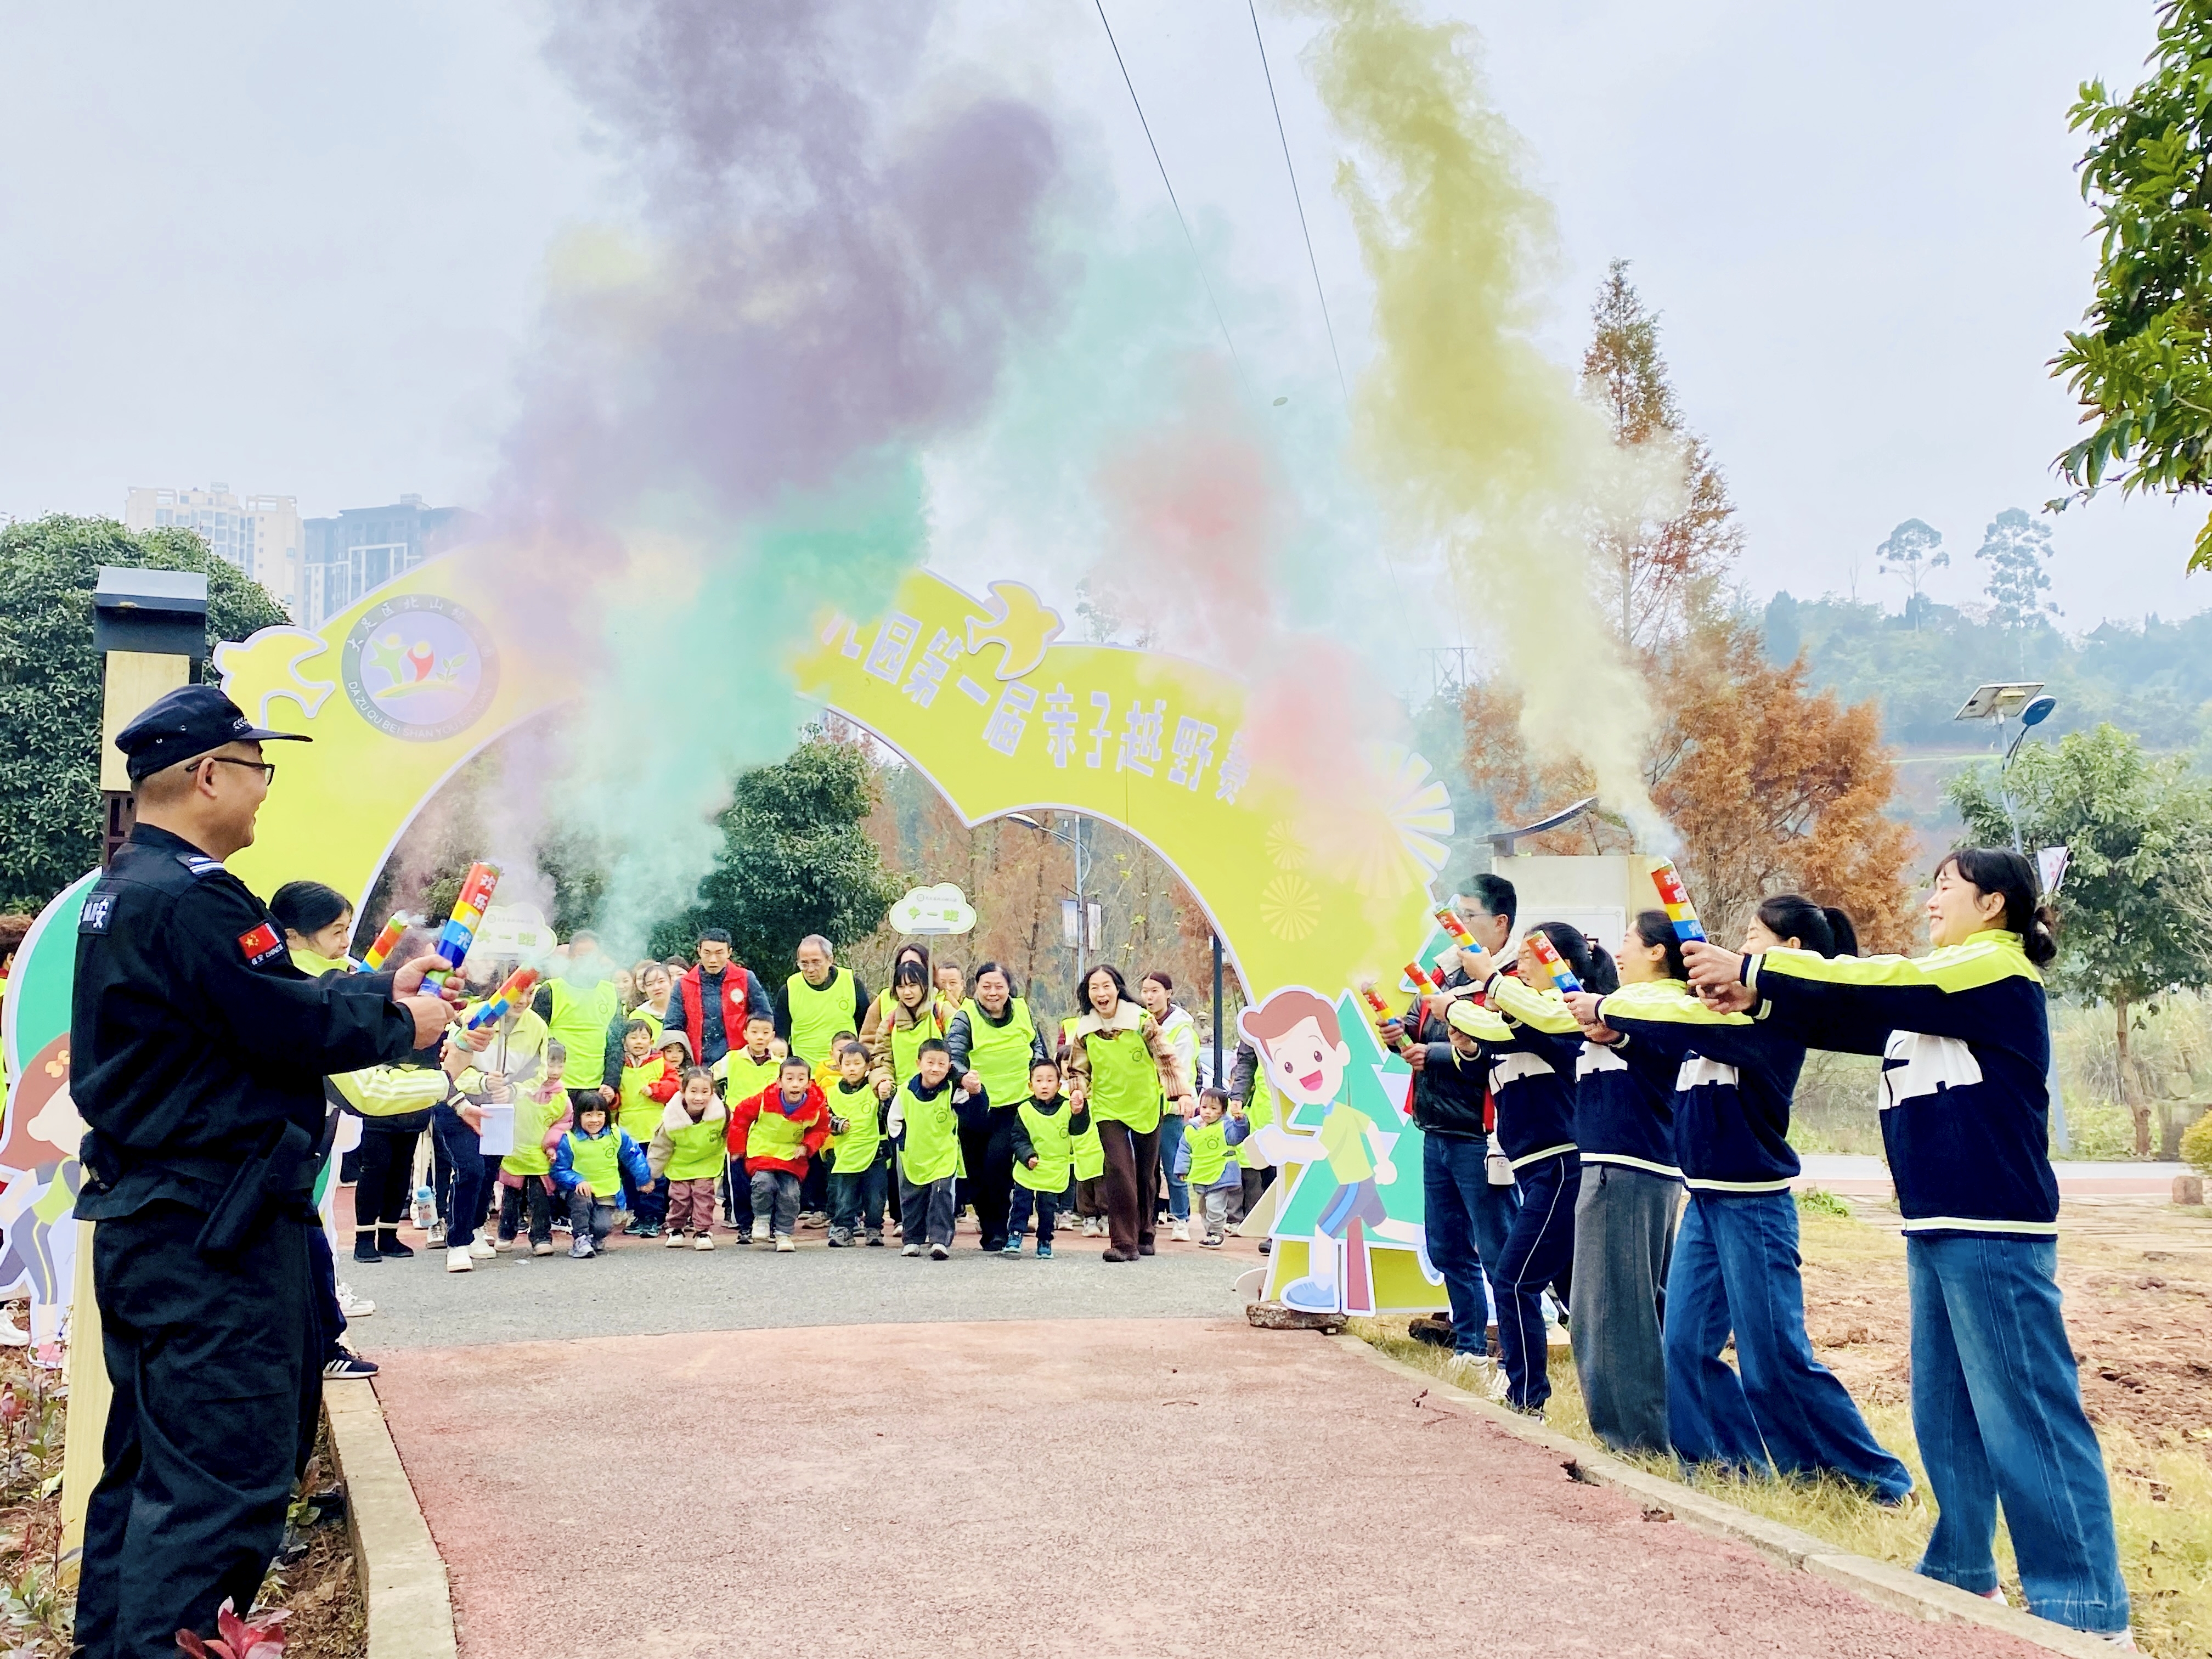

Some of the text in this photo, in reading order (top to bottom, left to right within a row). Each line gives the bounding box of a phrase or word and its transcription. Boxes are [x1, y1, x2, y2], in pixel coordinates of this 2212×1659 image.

[348, 681, 360, 697] DA
[355, 696, 370, 712] ZU
[366, 709, 383, 725] QU
[382, 719, 400, 734] BEI
[402, 727, 433, 738] SHAN
[436, 722, 459, 737] YOU
[459, 712, 476, 726] ER
[477, 928, 537, 947] 大一班
